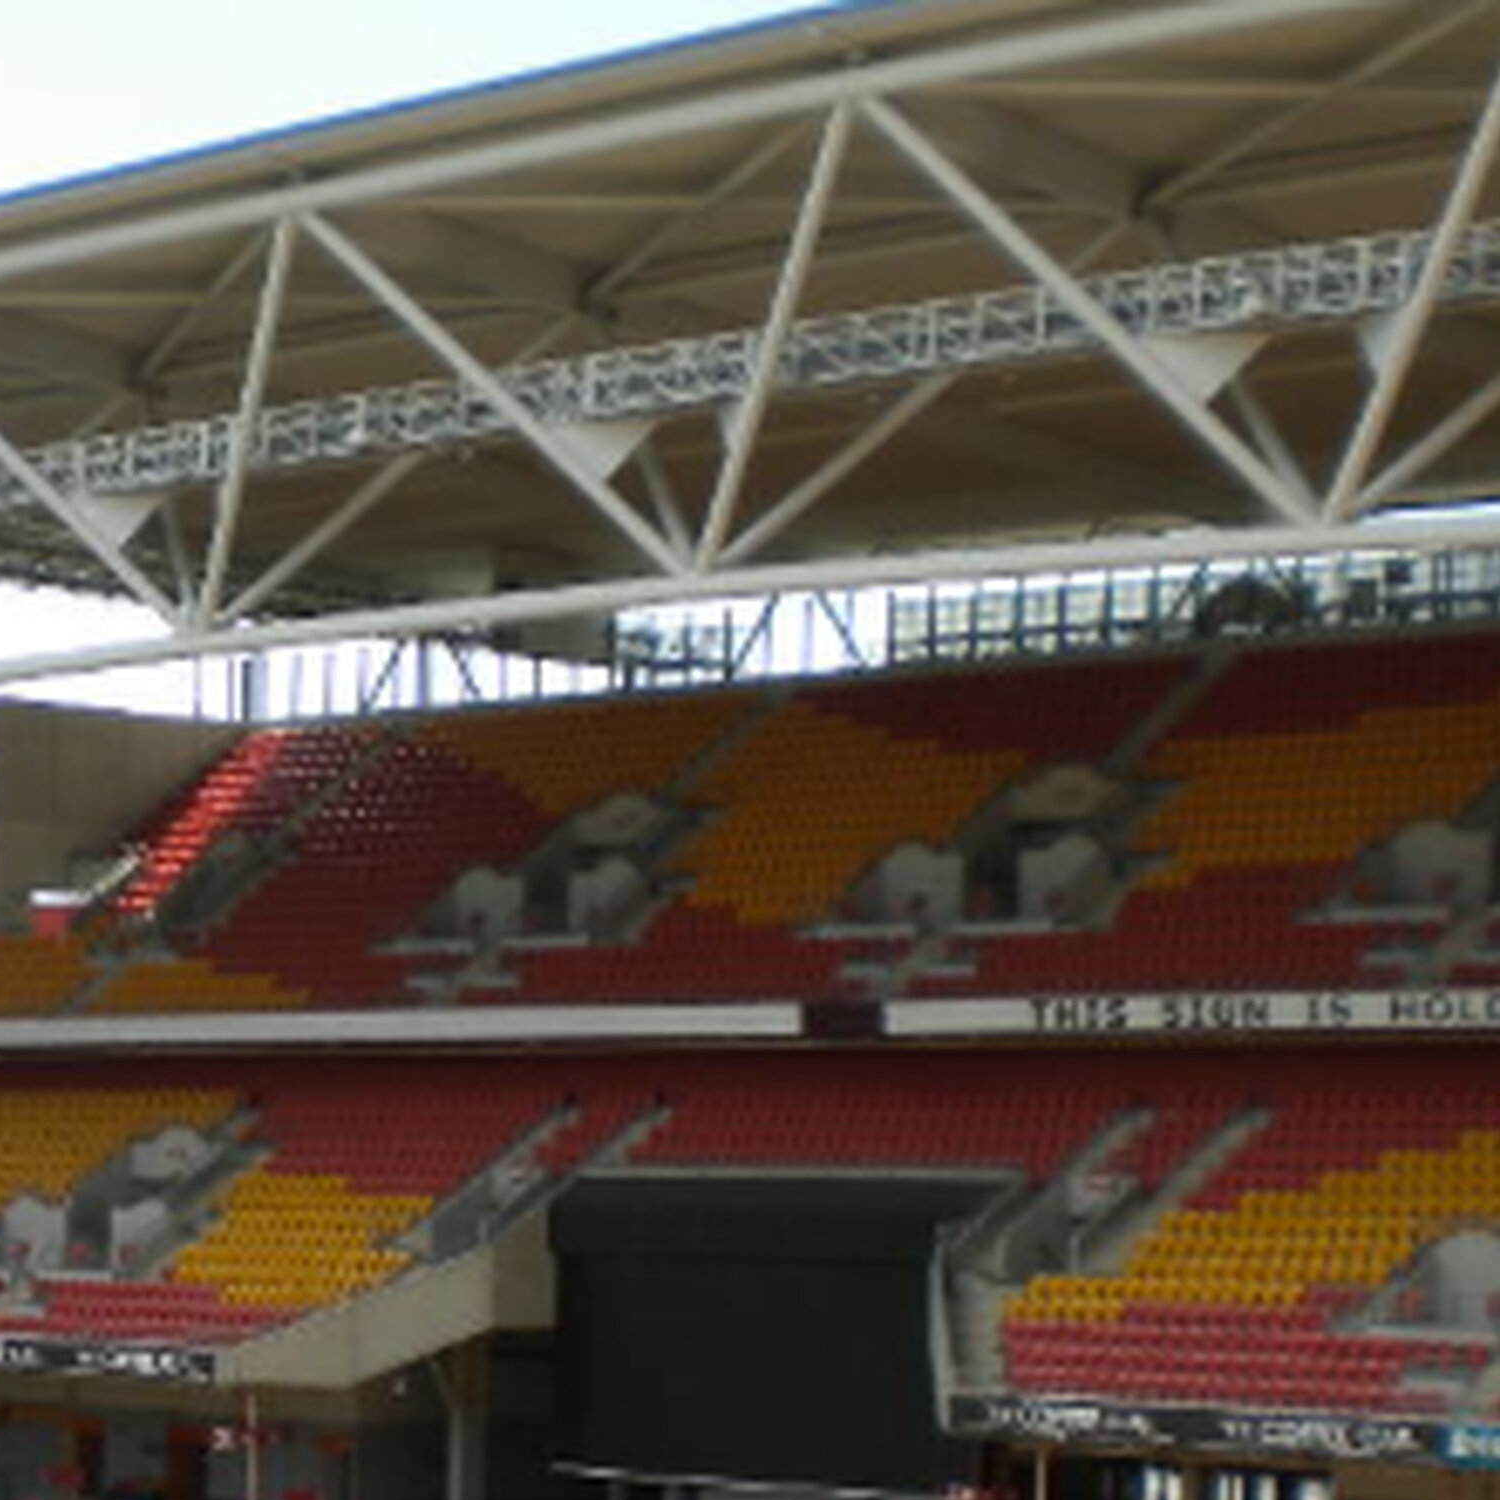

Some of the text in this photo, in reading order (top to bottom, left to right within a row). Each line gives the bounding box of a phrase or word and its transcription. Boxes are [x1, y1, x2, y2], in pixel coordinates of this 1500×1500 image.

[1031, 998, 1128, 1030] THIS
[1161, 997, 1270, 1029] SIGN
[1308, 997, 1353, 1026] IS
